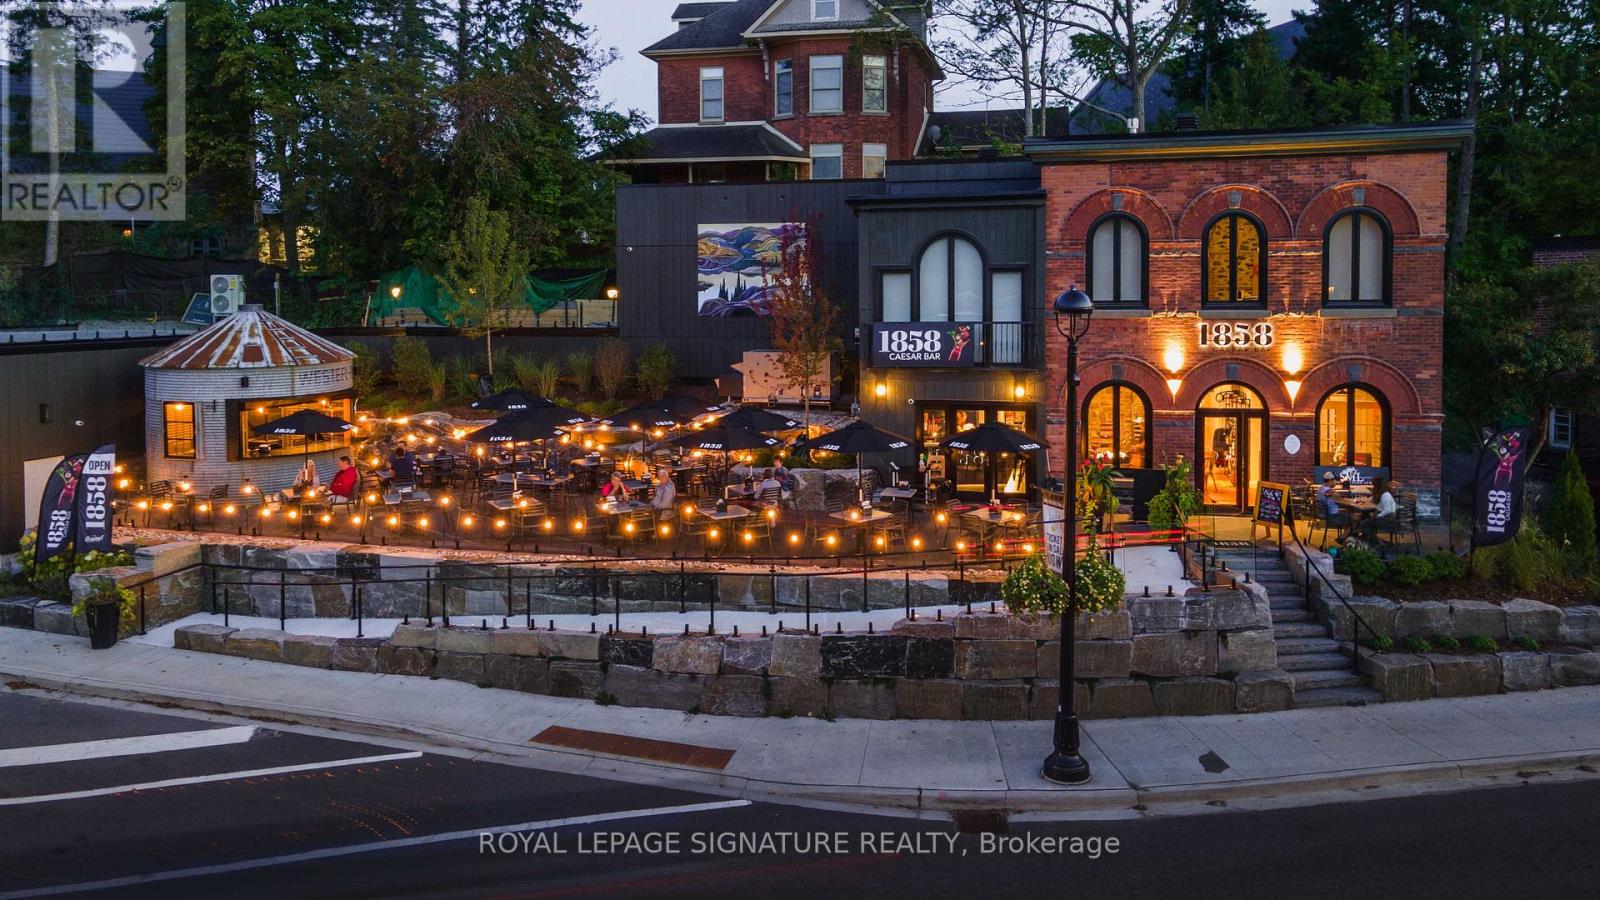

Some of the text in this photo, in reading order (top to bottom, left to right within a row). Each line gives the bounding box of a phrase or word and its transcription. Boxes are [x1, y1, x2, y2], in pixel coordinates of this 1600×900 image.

[879, 330, 941, 353] 1858
[1200, 323, 1273, 346] 1858
[889, 353, 941, 361] CAESAR BAR
[88, 460, 111, 471] OPEN
[85, 476, 106, 530] 1858
[1487, 490, 1506, 532] 1858
[46, 510, 68, 549] 1858
